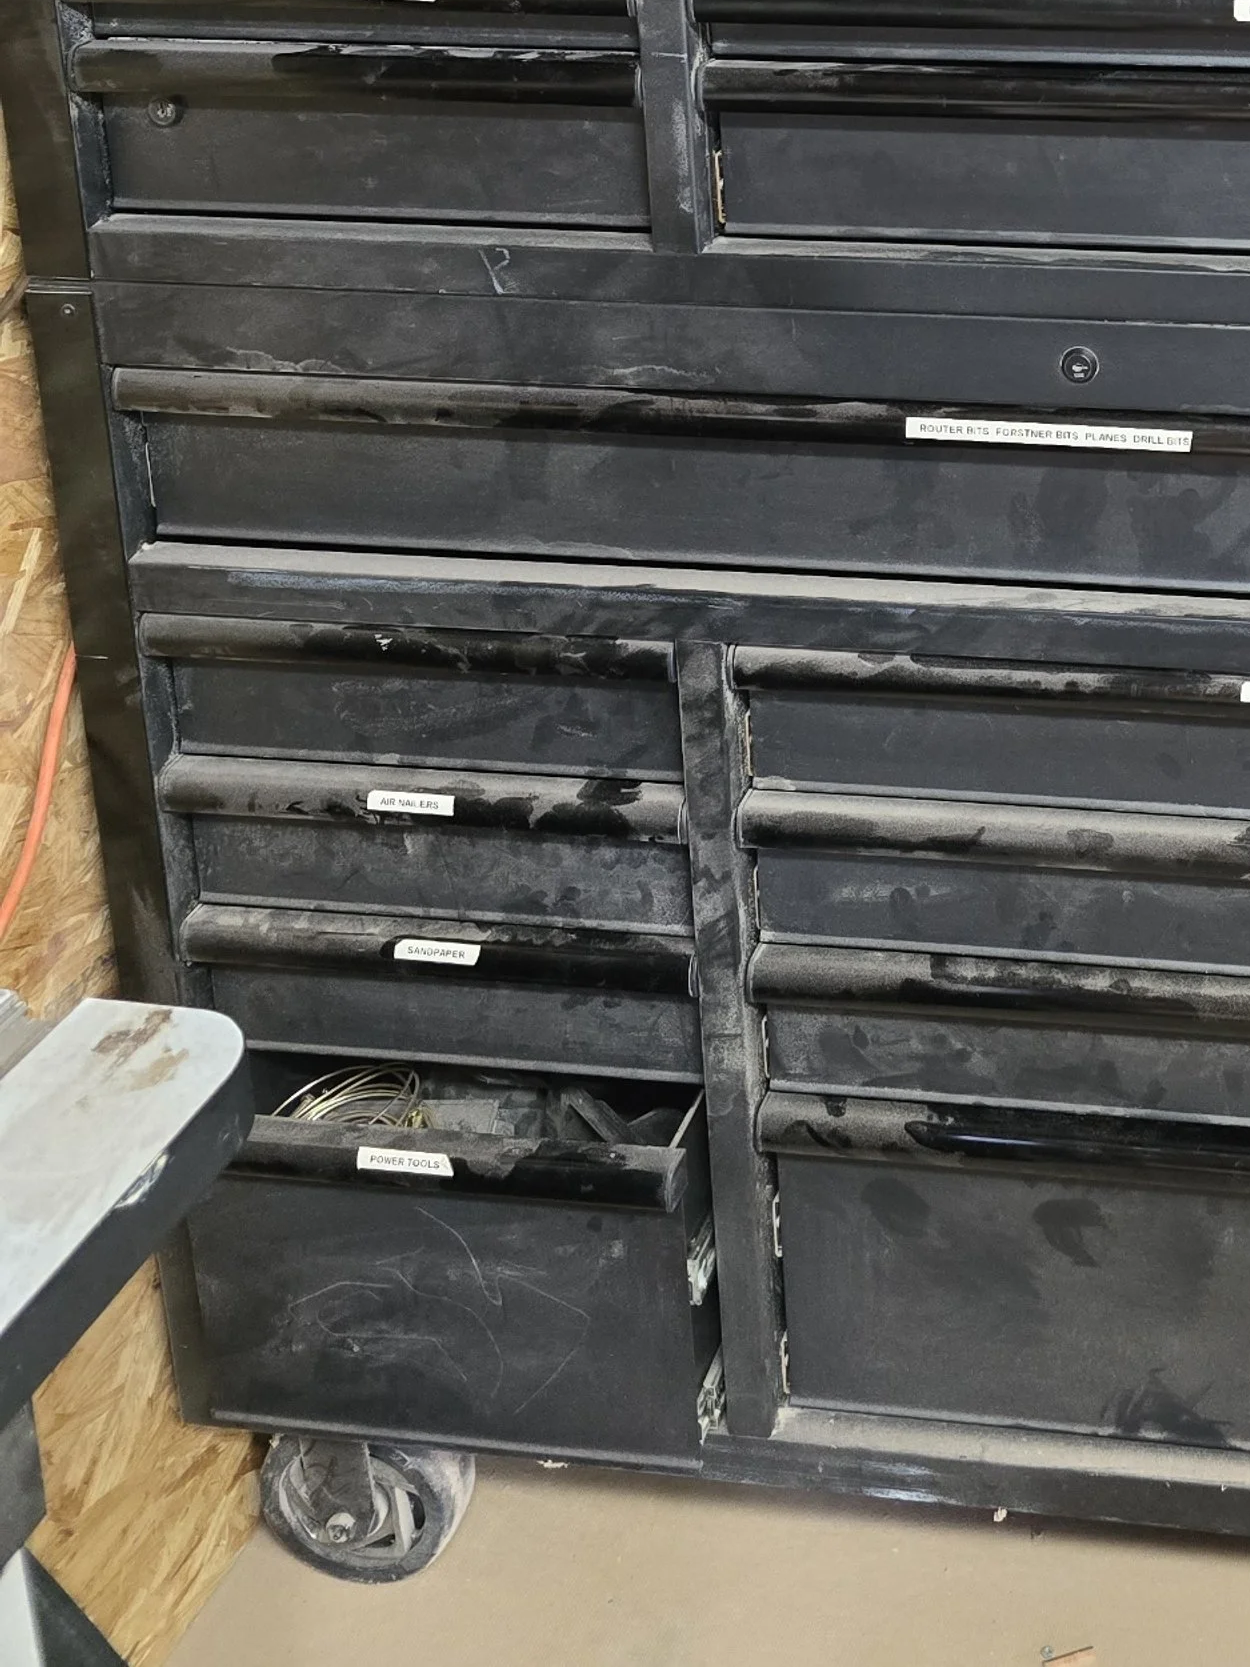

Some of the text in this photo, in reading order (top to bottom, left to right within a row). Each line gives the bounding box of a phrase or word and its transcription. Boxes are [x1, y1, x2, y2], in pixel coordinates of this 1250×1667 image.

[919, 423, 1190, 447] ROUTER BITS FORSTNER BITS PLANES DRILL BITS
[379, 797, 439, 810] AIR NAILERS
[407, 945, 466, 959] SANDPAPER
[370, 1154, 440, 1170] POWER TOOLS
